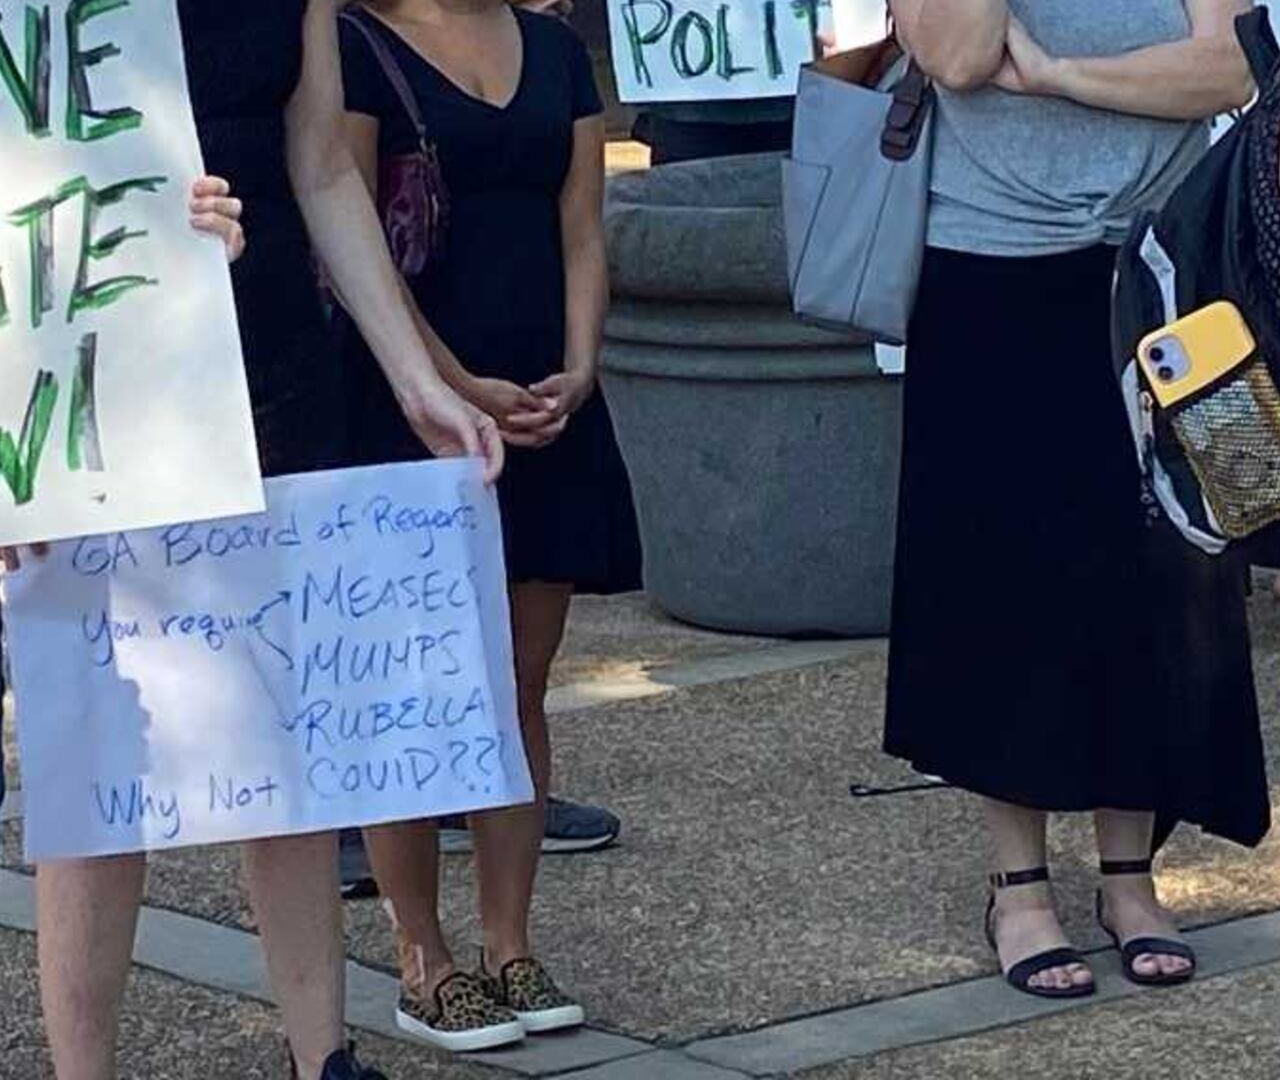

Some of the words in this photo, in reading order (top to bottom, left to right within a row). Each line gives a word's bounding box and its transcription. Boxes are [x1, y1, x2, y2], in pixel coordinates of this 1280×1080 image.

[71, 531, 138, 576] GA
[161, 517, 301, 567] Board
[318, 503, 355, 542] of
[82, 608, 141, 668] You
[301, 629, 463, 696] MUMPS
[303, 687, 485, 754] RUBELLA
[94, 781, 181, 838] Why
[208, 773, 280, 814] Not
